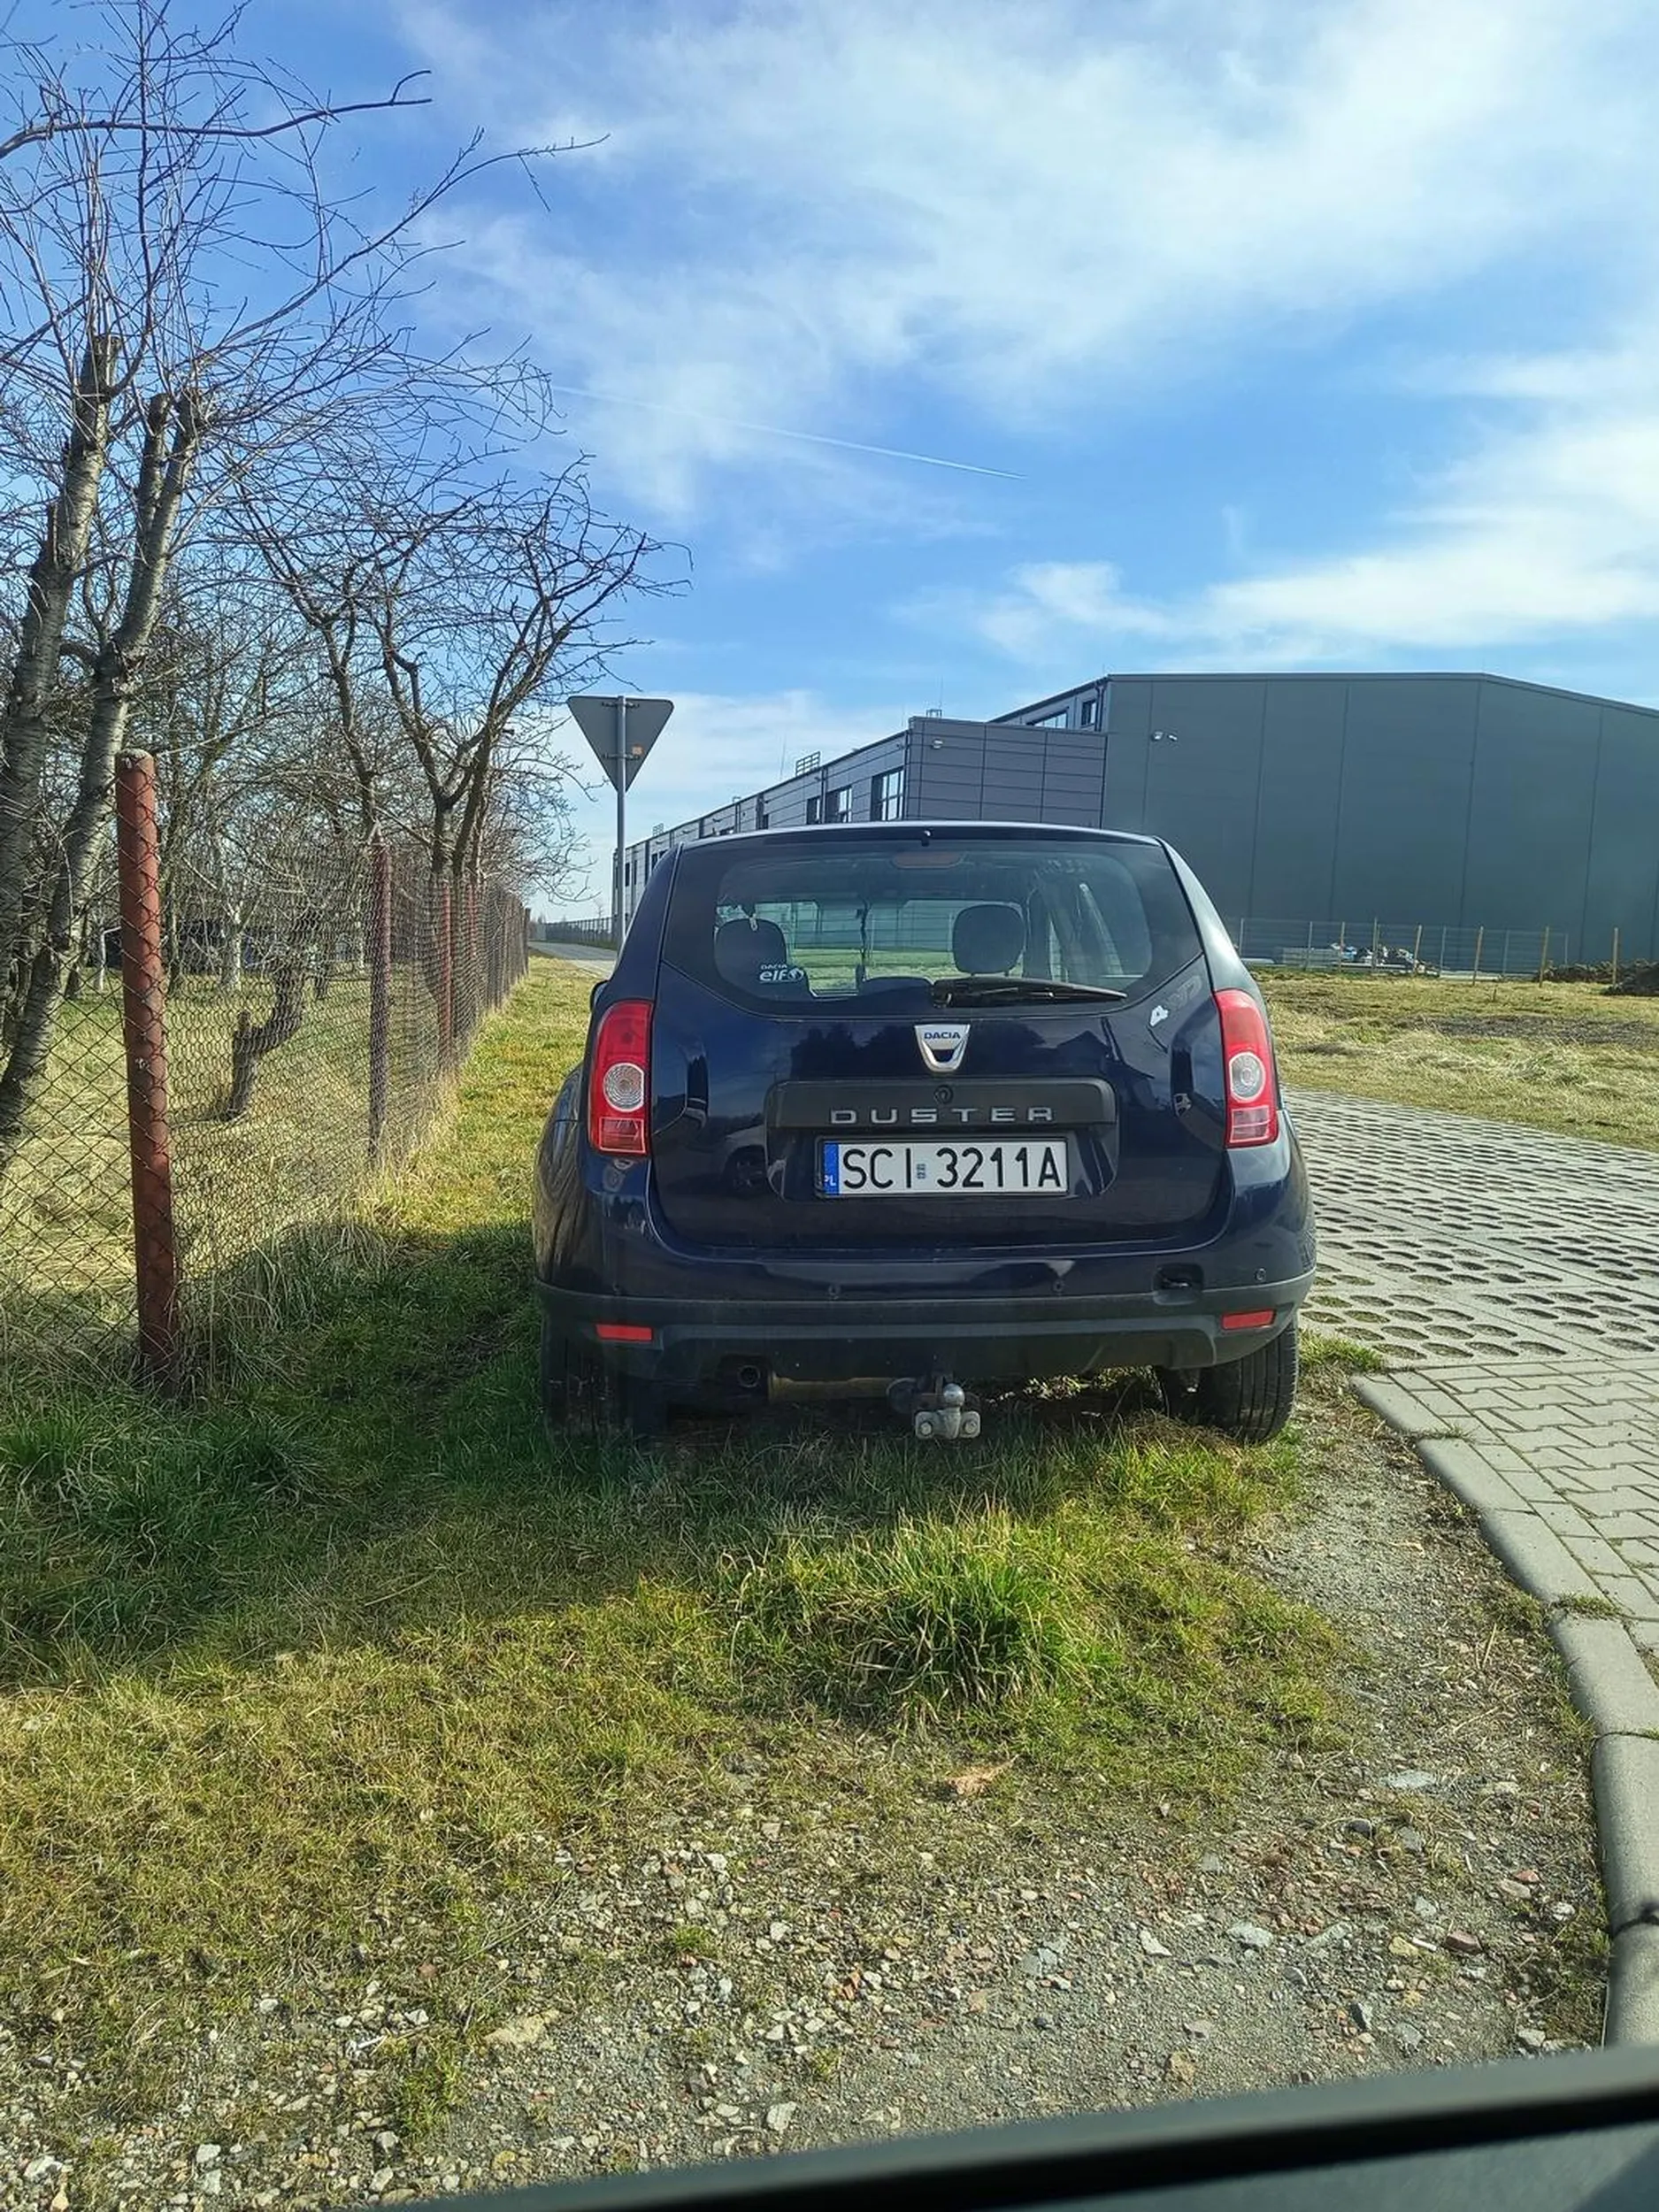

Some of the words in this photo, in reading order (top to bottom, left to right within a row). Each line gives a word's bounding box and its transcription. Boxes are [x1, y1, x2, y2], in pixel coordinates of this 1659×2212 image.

[830, 1106, 1055, 1125] DUSTER
[842, 1148, 911, 1189] SCI
[935, 1147, 1062, 1189] 3211A
